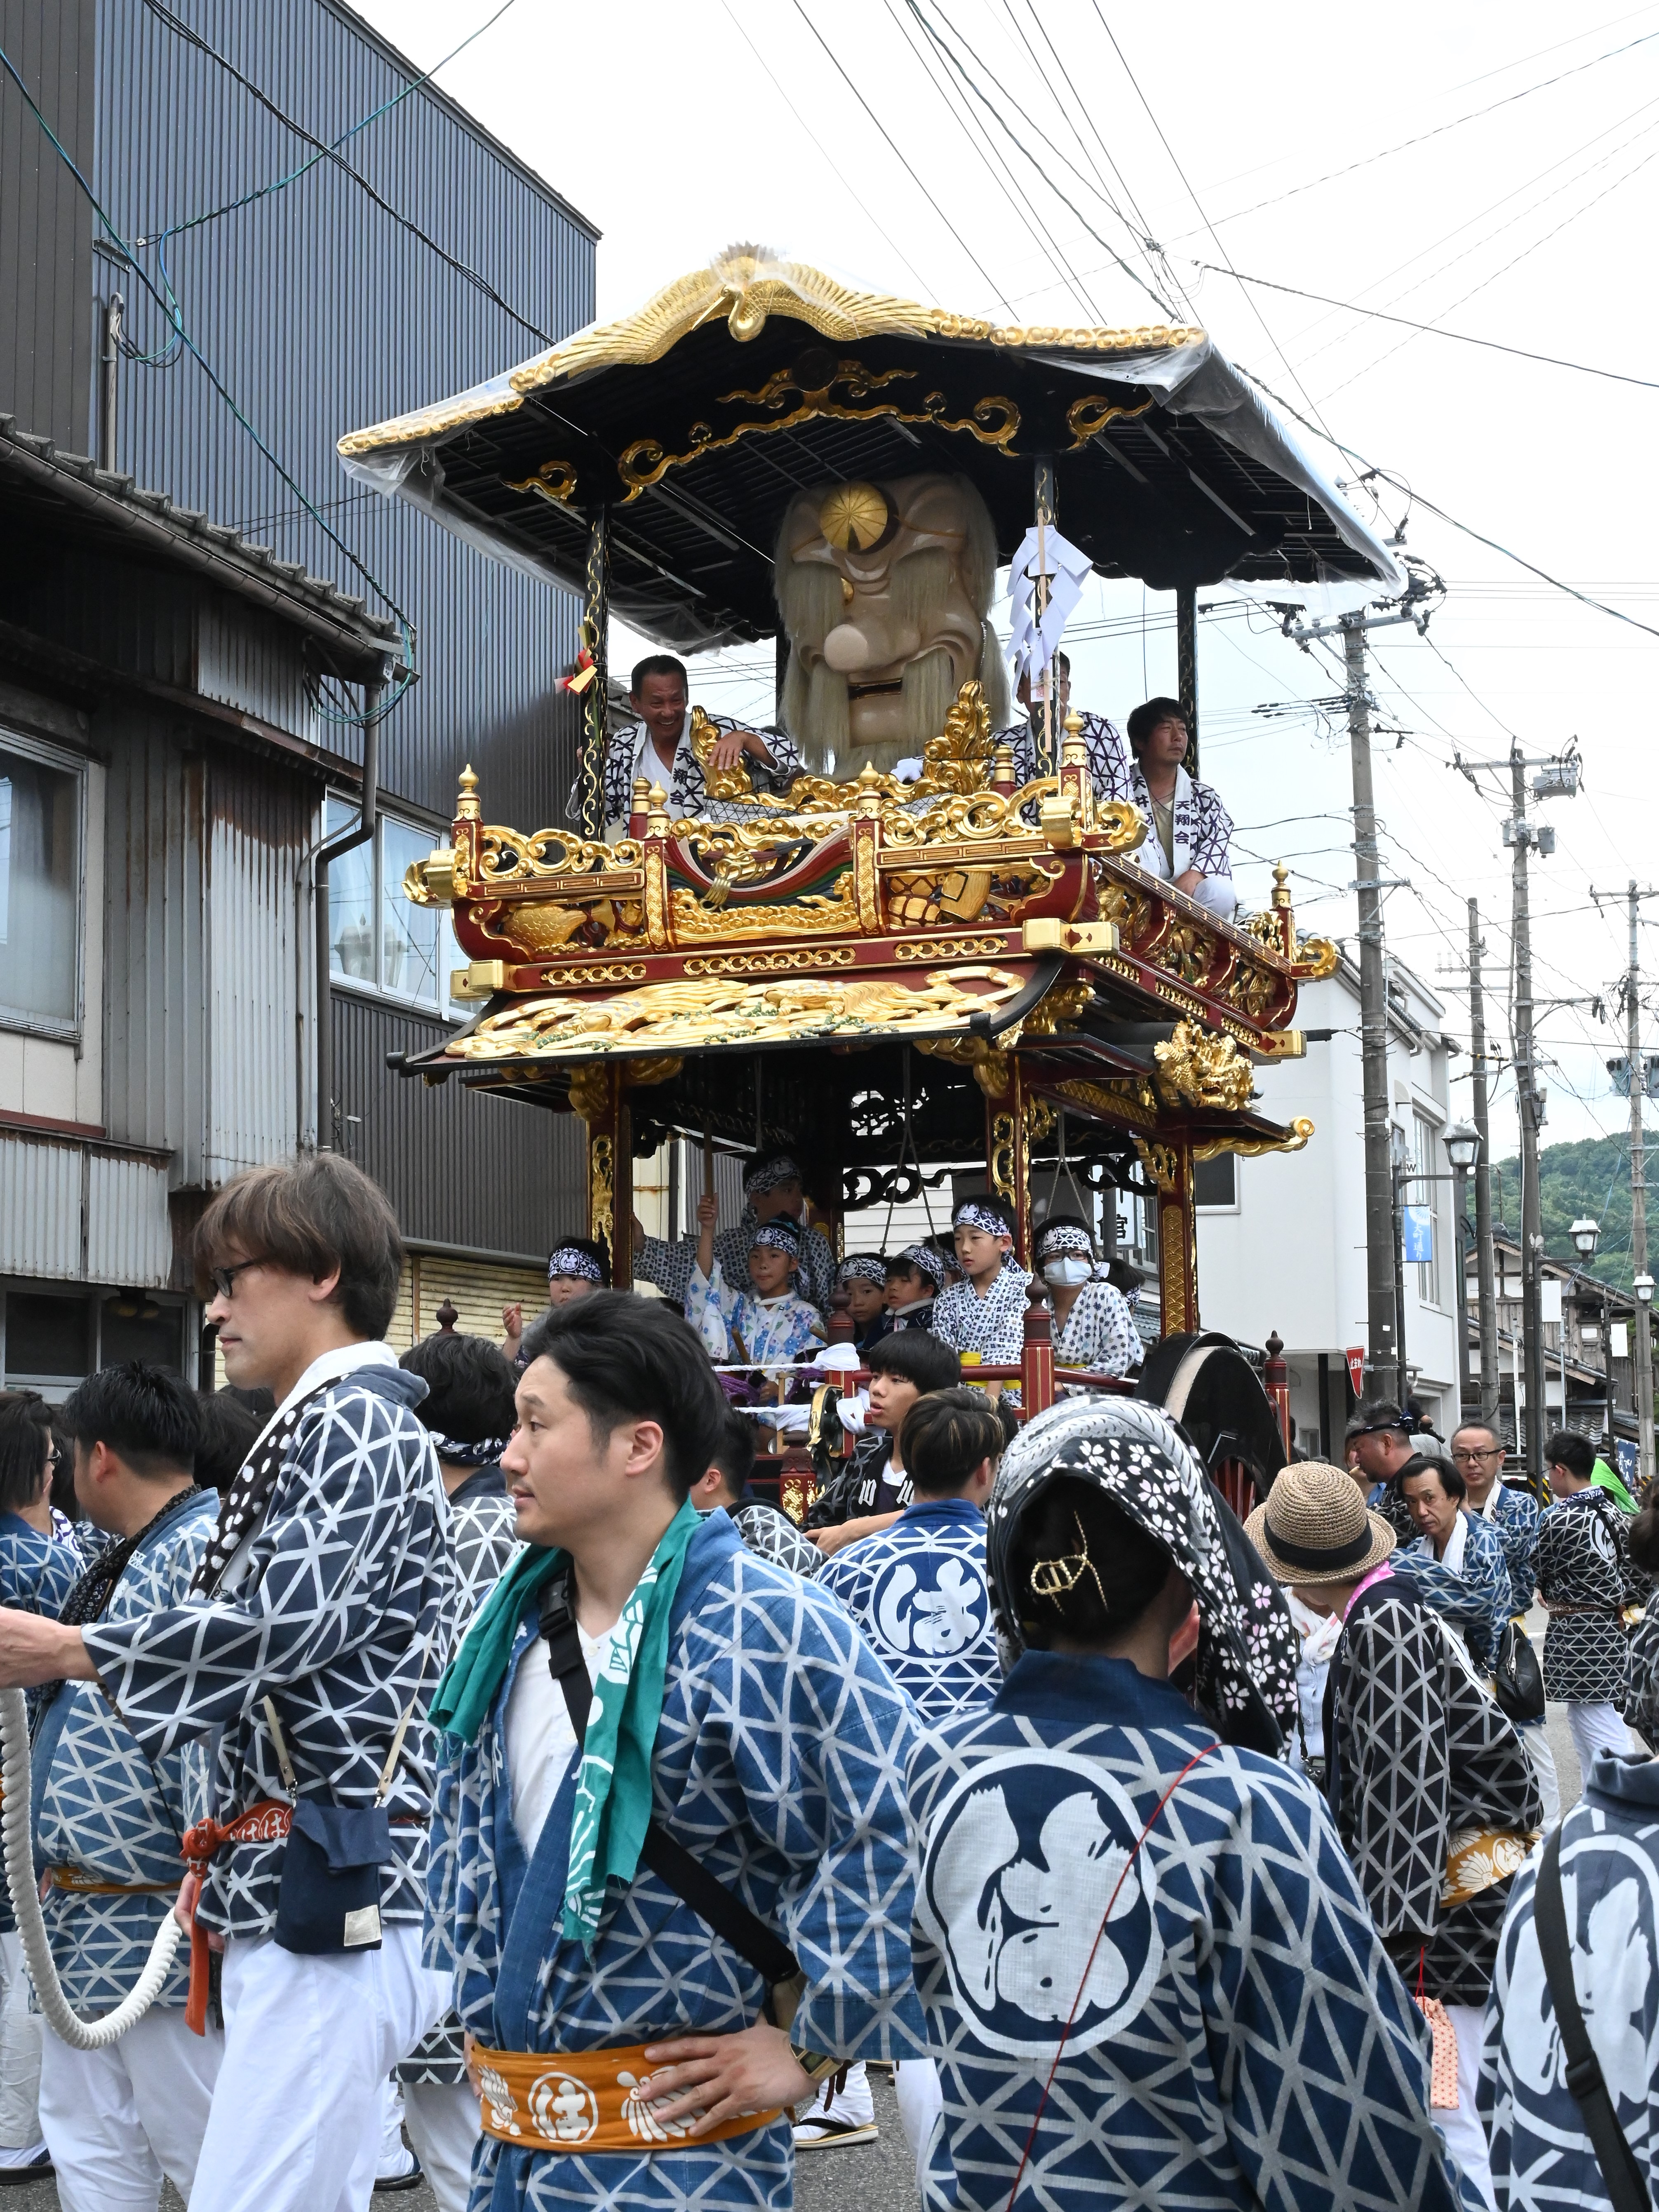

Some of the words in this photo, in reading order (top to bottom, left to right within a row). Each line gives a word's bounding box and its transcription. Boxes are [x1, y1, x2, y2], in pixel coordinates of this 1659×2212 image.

[670, 748, 691, 807] 天翔会
[1175, 800, 1190, 845] 天翔会
[1406, 1164, 1417, 1173] W
[1412, 1222, 1424, 1261] 大町通り
[1350, 1357, 1362, 1369] 止まれ
